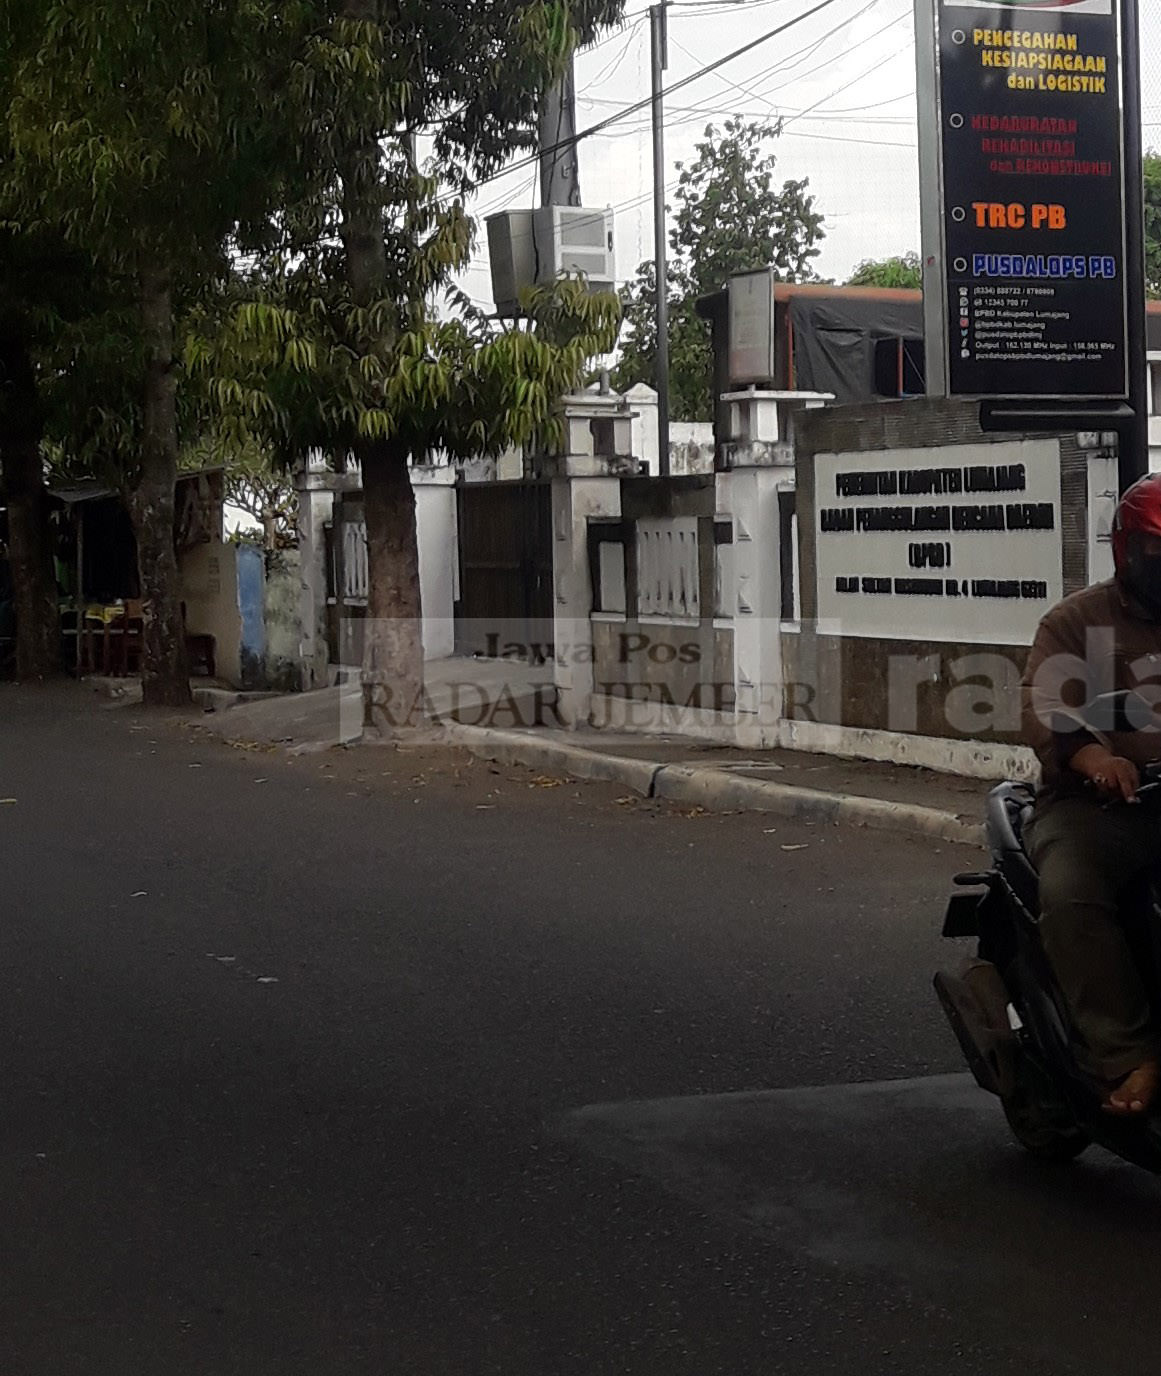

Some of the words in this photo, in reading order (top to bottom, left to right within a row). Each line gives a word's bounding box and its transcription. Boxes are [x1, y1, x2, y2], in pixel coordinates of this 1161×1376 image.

[973, 28, 1077, 51] PENCEGAHAN
[982, 49, 1106, 73] KESIAPSIAGAAN
[1007, 72, 1035, 89] dan
[1038, 73, 1106, 93] LOGISTIK
[972, 201, 1026, 229] TRC
[1031, 203, 1067, 230] PB
[973, 253, 1087, 278] PUSDALOPS
[1089, 255, 1116, 279] PB
